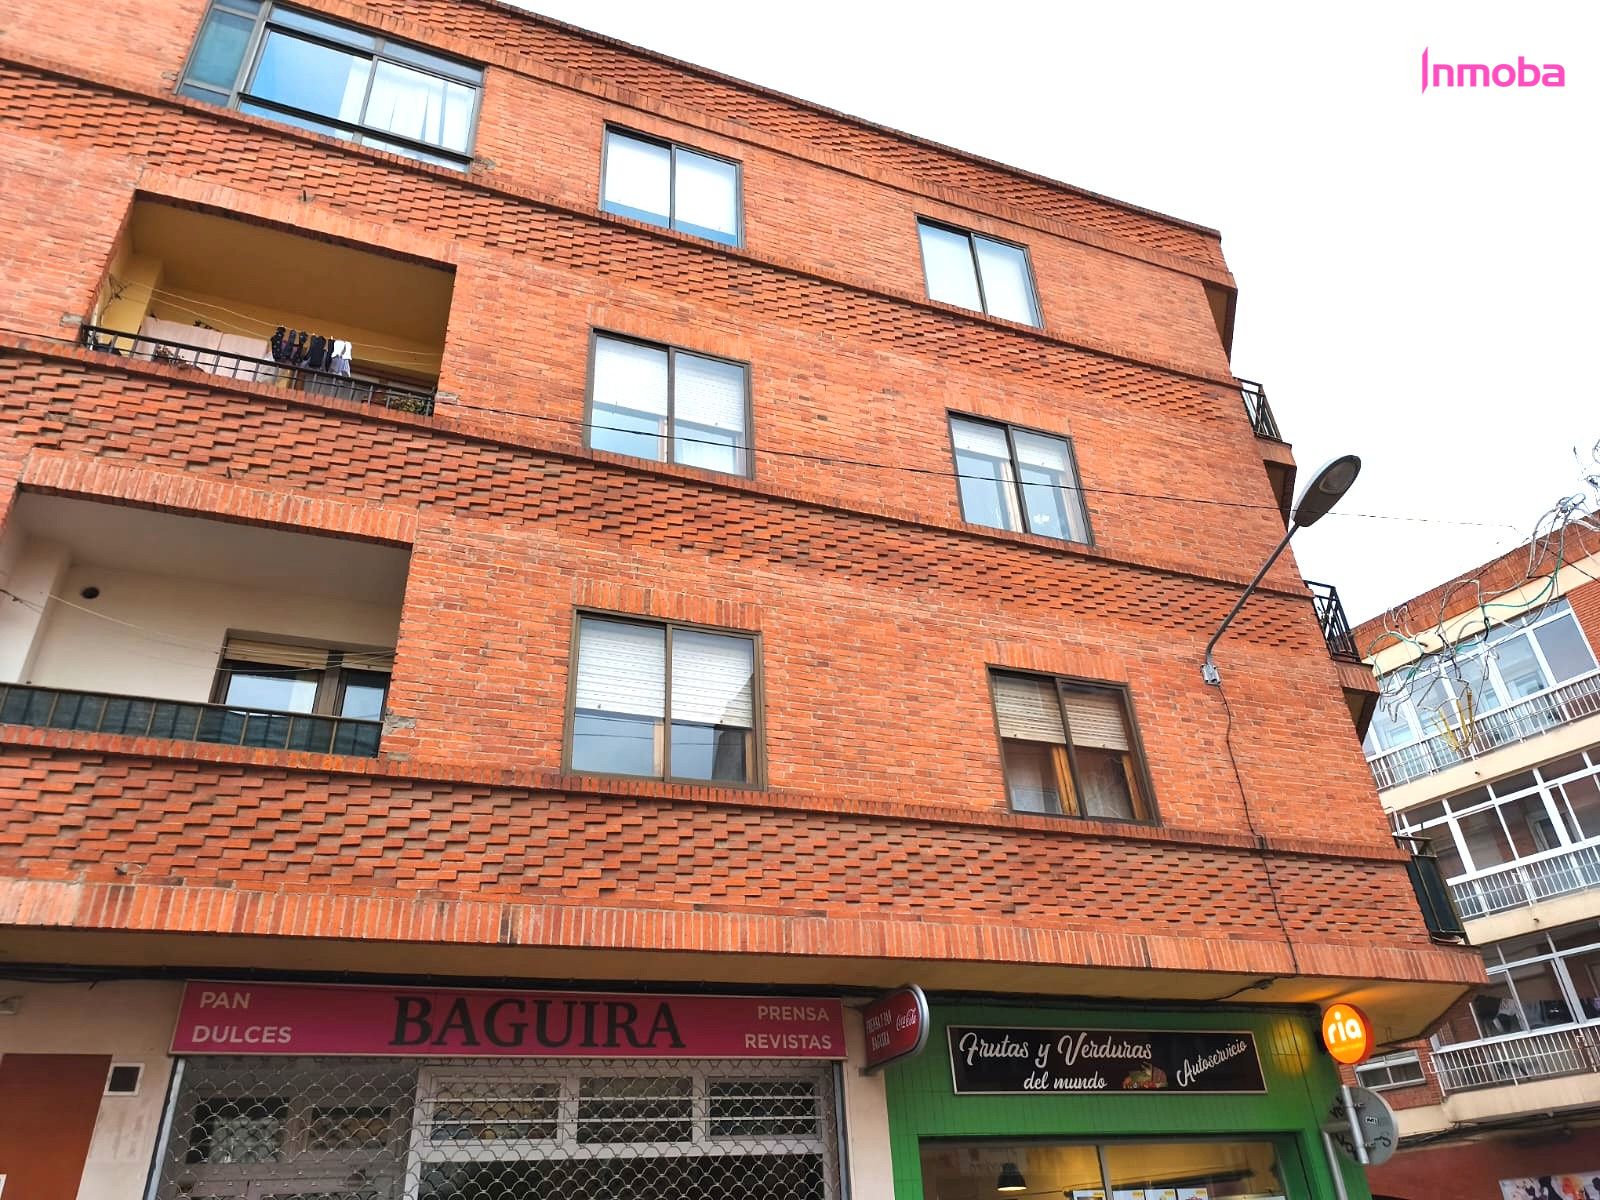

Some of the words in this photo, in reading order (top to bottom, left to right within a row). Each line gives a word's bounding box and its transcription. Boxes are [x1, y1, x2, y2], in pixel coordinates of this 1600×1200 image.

[200, 991, 251, 1009] PAN
[388, 996, 686, 1049] BAGUIRA
[758, 1005, 829, 1022] PRENSA
[191, 1025, 292, 1044] DULCES
[1327, 1011, 1362, 1044] ria
[745, 1033, 832, 1050] REVISTAS
[959, 1032, 1029, 1066] Frutas
[1035, 1042, 1051, 1068] y
[1057, 1031, 1152, 1066] Verduras
[1176, 1038, 1248, 1087] Autoservicio
[1023, 1071, 1049, 1090] del
[1053, 1071, 1108, 1090] mundo
